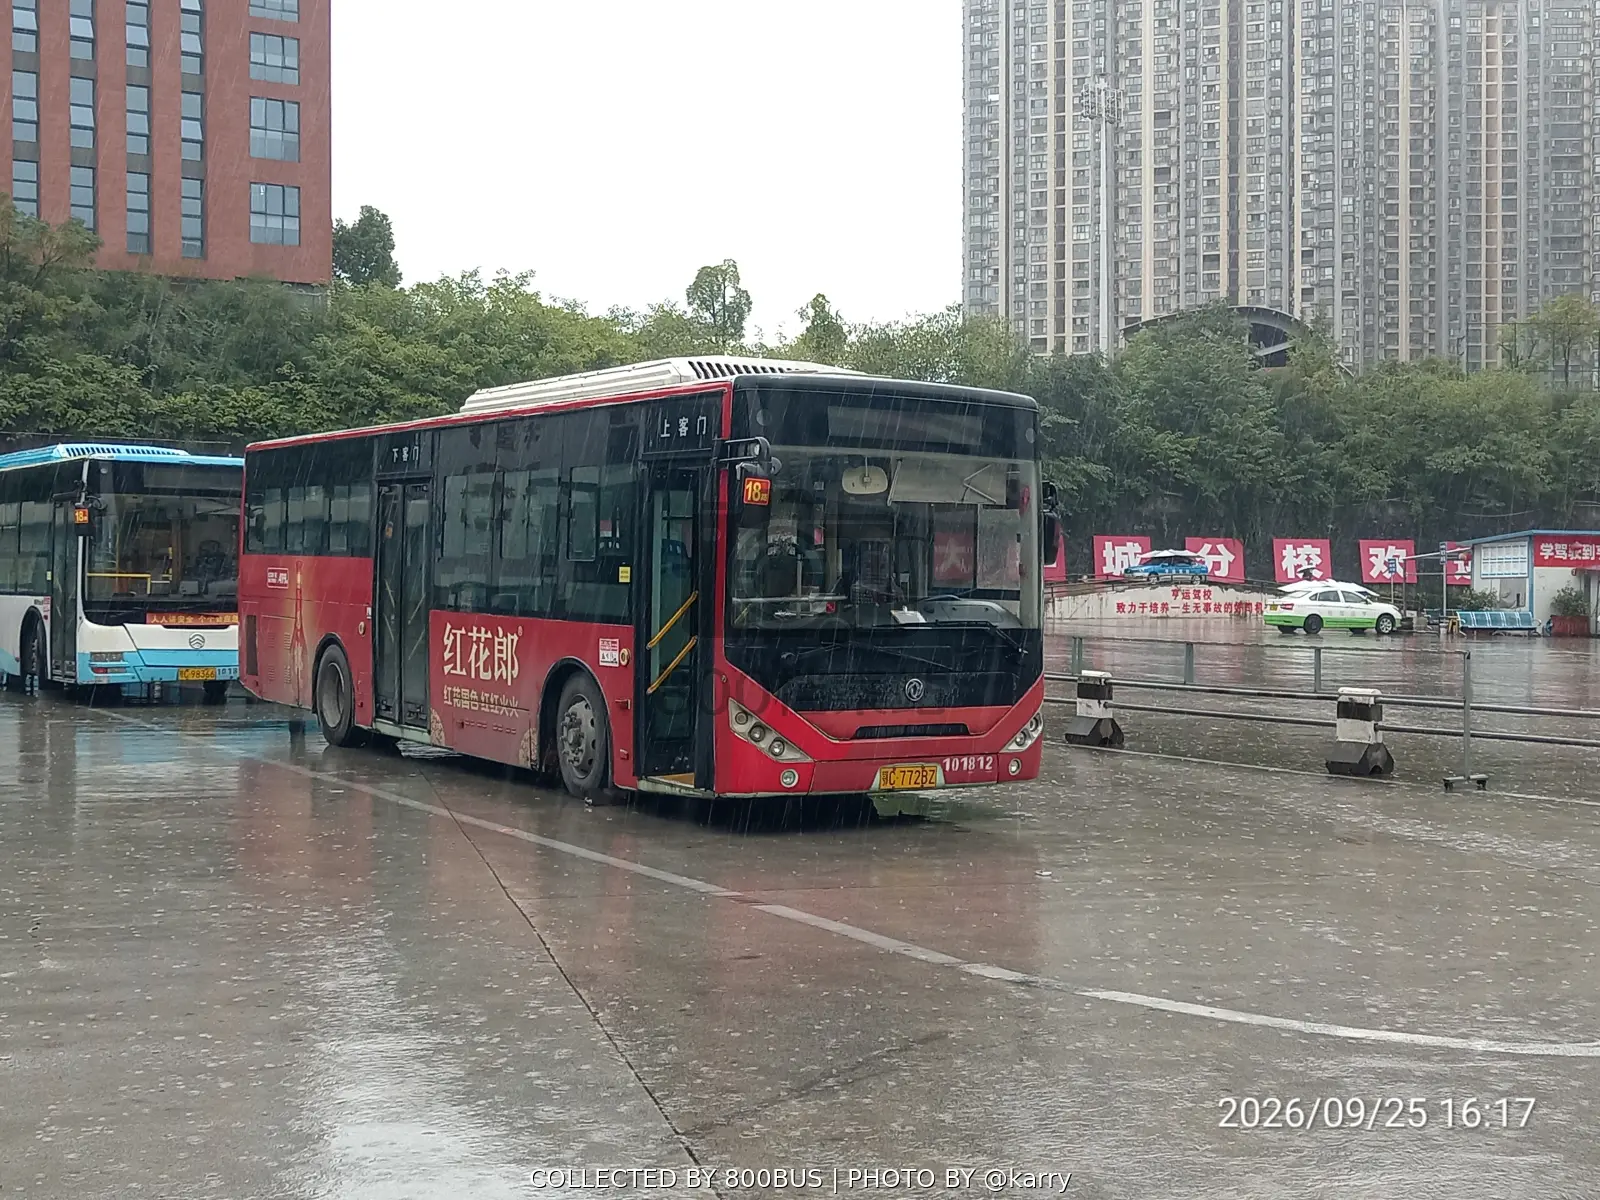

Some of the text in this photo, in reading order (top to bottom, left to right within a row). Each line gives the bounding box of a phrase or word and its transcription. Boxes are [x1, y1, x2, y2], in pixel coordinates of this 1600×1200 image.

[661, 416, 706, 438] 上客门
[392, 446, 419, 462] 下客门
[443, 622, 519, 686] 红花郎
[943, 756, 993, 772] 101812
